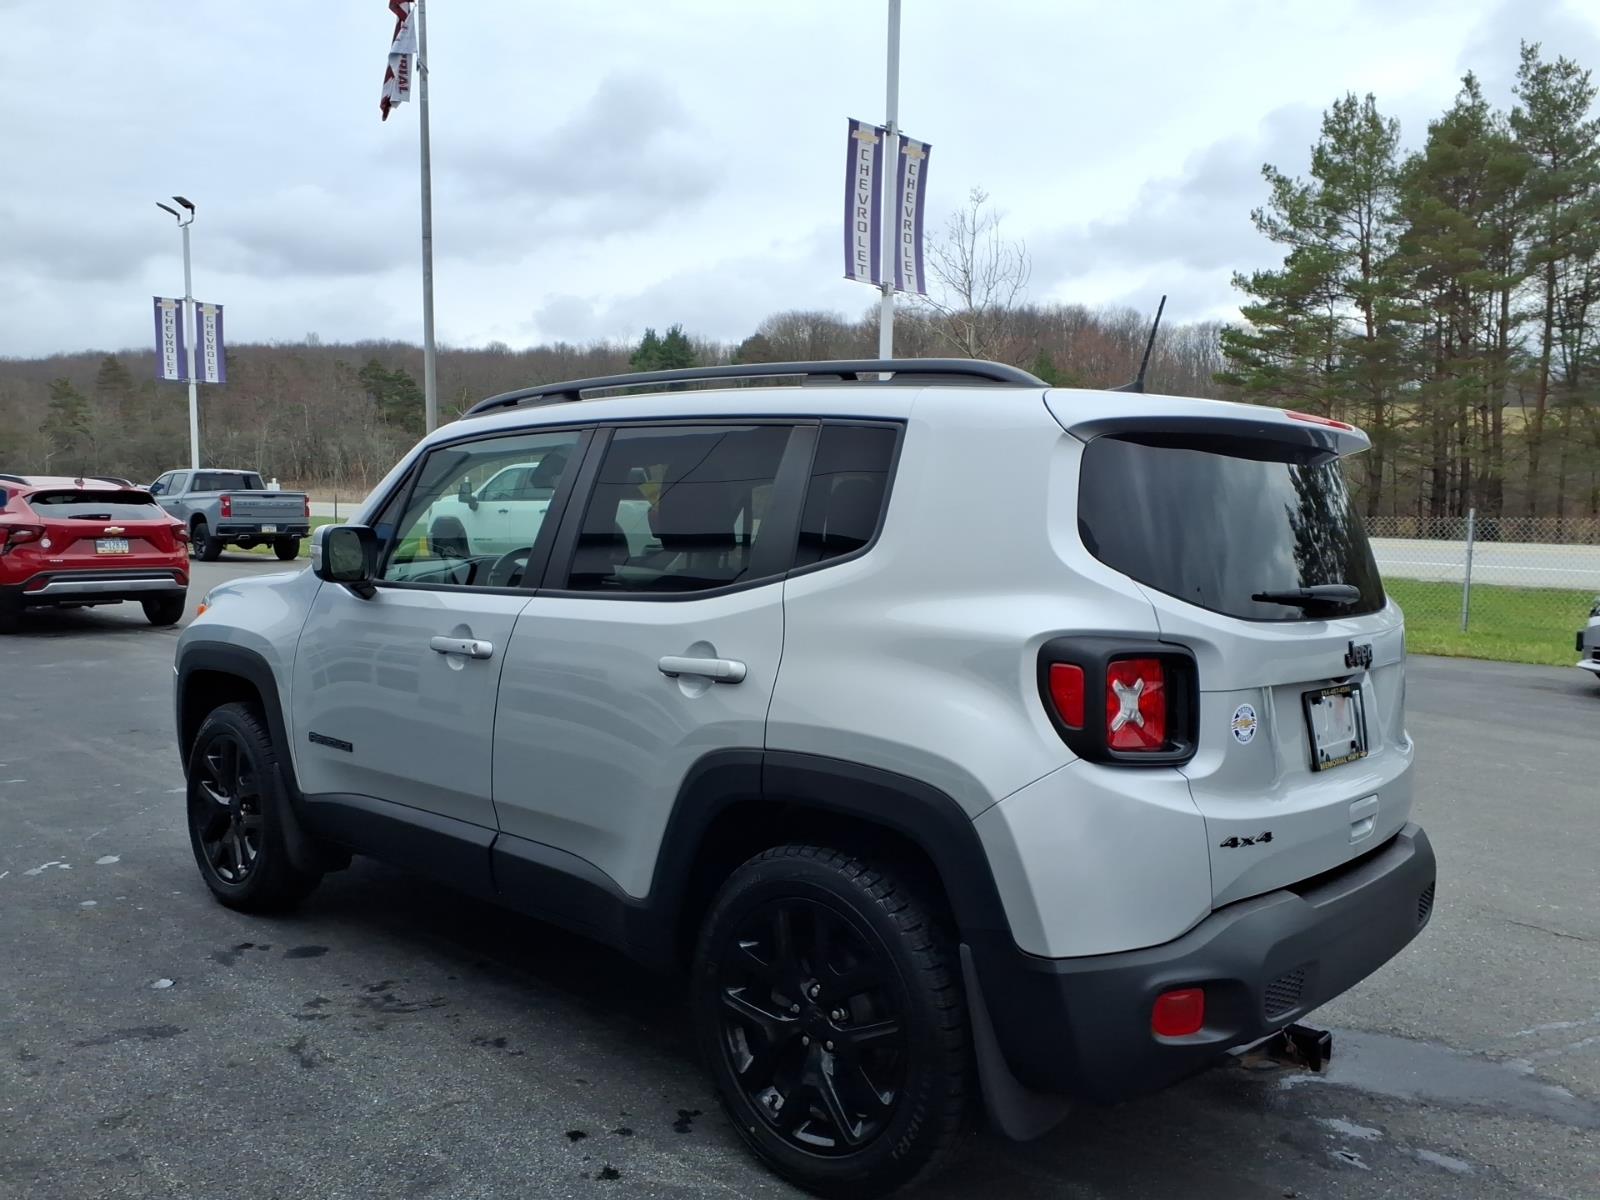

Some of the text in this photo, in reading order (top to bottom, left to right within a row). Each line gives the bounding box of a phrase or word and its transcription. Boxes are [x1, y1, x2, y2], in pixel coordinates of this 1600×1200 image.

[857, 149, 870, 275] CHEVROLET
[903, 164, 917, 285] CHEVROLET
[164, 311, 175, 374] CHEVROLET
[206, 316, 215, 379] CHEVROLET
[1344, 640, 1373, 670] Jeep
